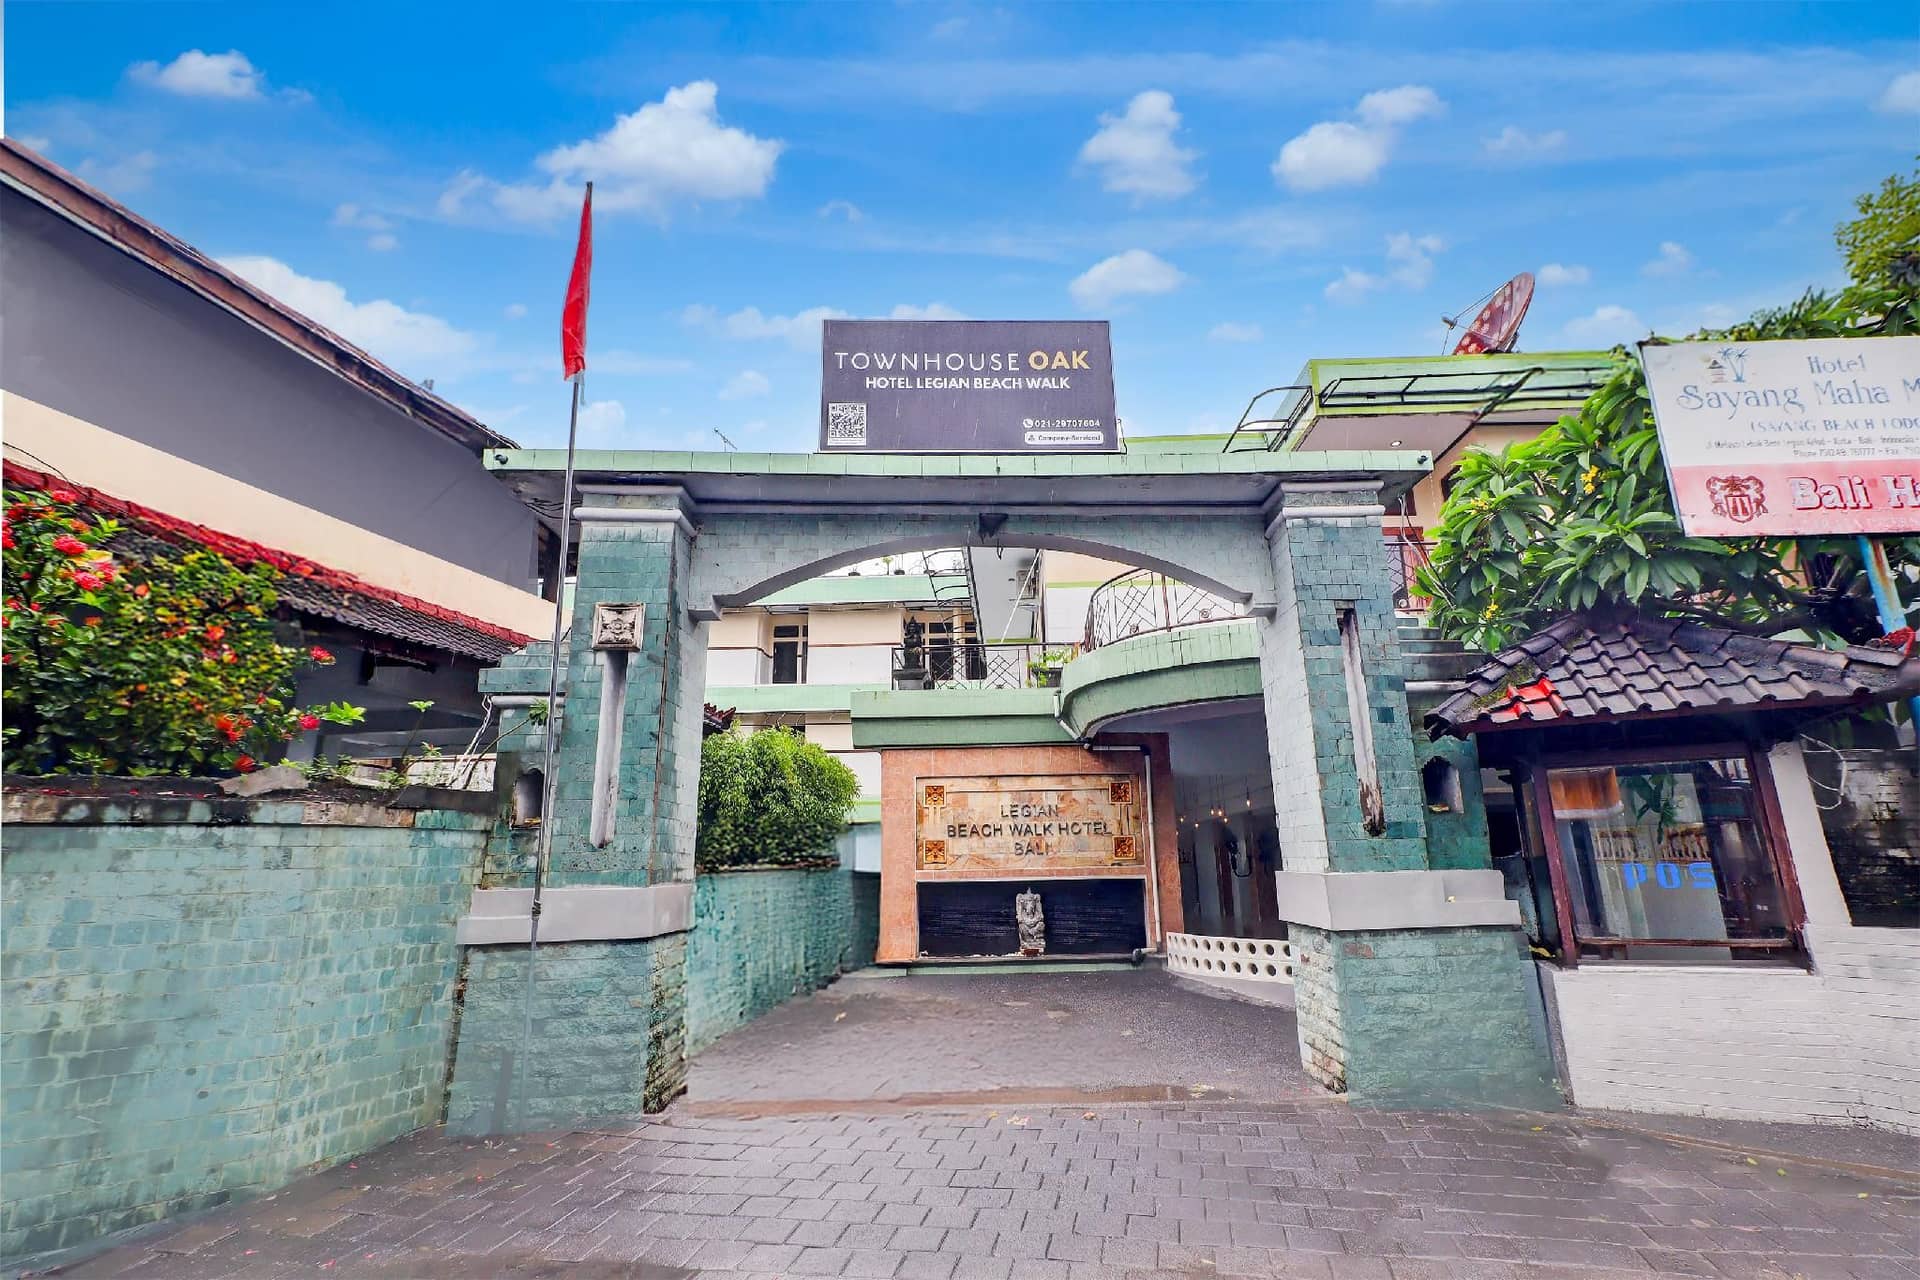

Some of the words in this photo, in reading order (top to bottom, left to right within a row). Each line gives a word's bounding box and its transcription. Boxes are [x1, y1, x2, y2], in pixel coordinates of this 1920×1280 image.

[834, 351, 1020, 372] TOWNHOUSE
[1028, 350, 1091, 370] OAK
[1806, 353, 1865, 374] Hotel
[865, 376, 913, 389] HOTEL
[916, 376, 970, 389] LEGIAN
[973, 376, 1022, 389] BEACH
[1023, 376, 1071, 389] WALK
[1676, 384, 1805, 420] Sayang
[1813, 379, 1889, 405] Maha
[1823, 418, 1875, 431] BEACH
[1785, 474, 1873, 511] Bali
[1000, 804, 1059, 818] LEGIAN
[946, 823, 1003, 838] BEACH
[1009, 822, 1054, 837] WALK
[1058, 821, 1113, 837] HOTEL
[1014, 842, 1053, 856] BALI
[1622, 862, 1716, 889] POS
